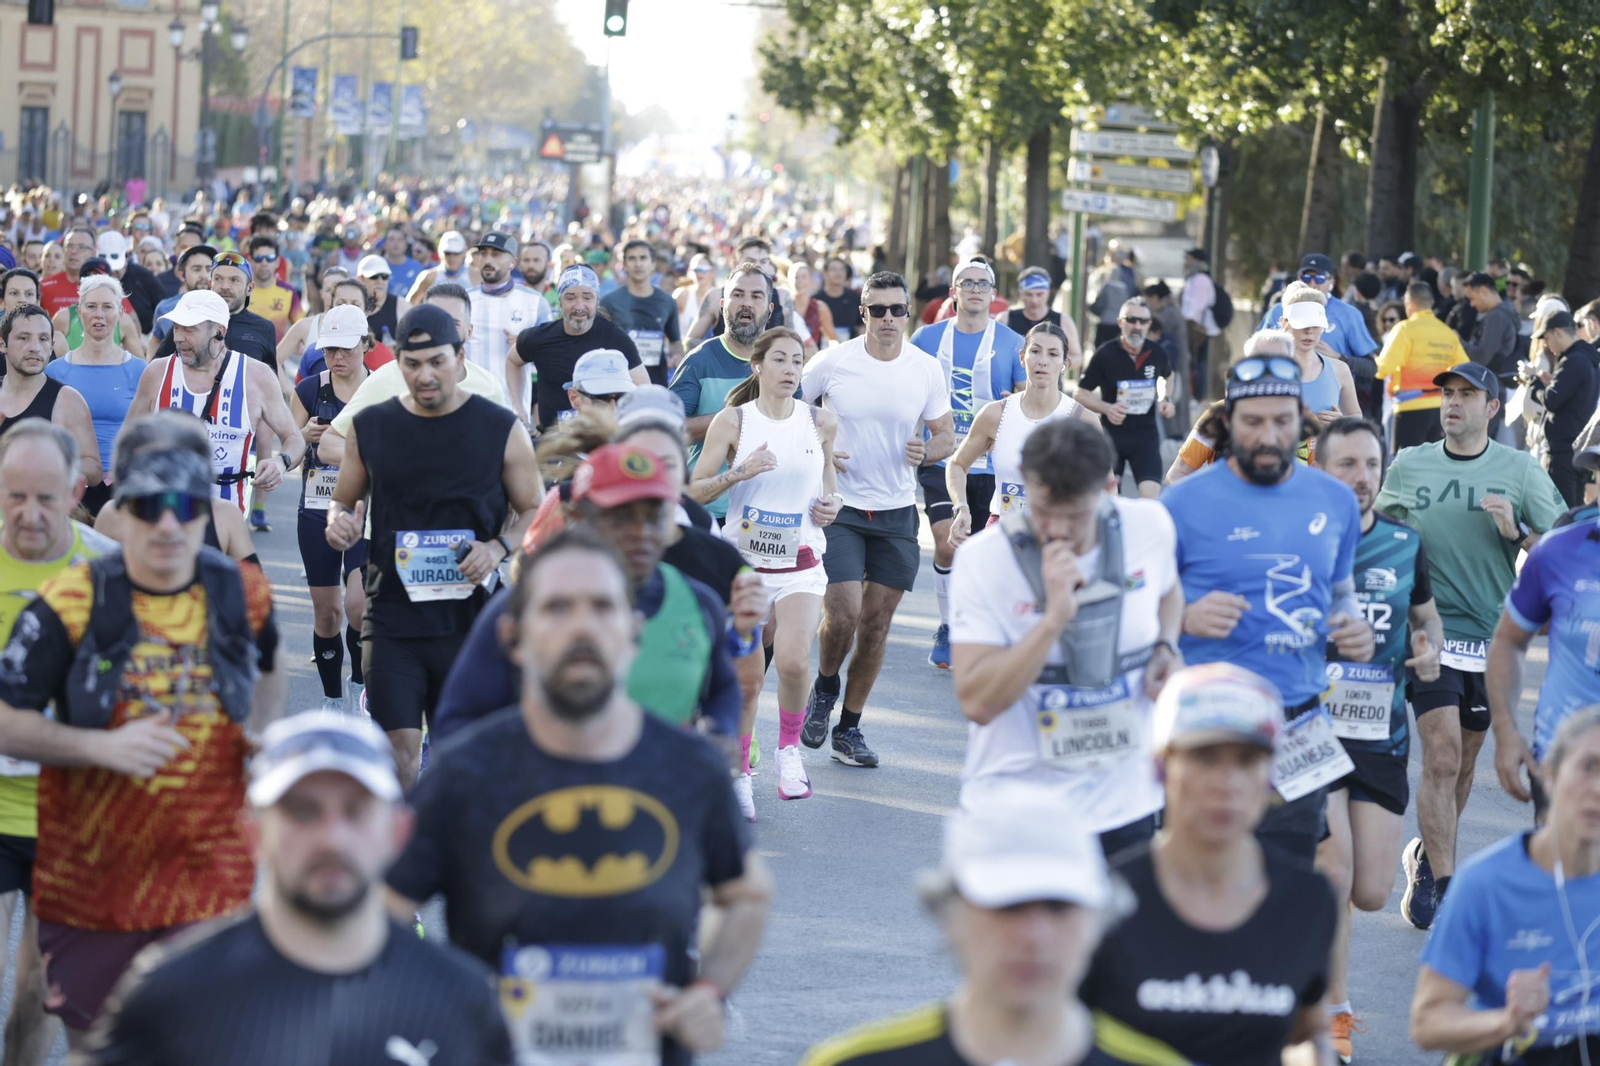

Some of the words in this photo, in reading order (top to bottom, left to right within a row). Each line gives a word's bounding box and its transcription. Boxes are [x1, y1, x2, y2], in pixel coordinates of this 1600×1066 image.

[761, 514, 796, 525] ZURICH
[423, 534, 467, 545] ZURICH
[759, 530, 782, 541] 12790
[749, 539, 786, 555] MARIA
[425, 555, 448, 565] 4463
[1347, 667, 1388, 680] ZURICH
[1052, 729, 1130, 757] LINCOLN
